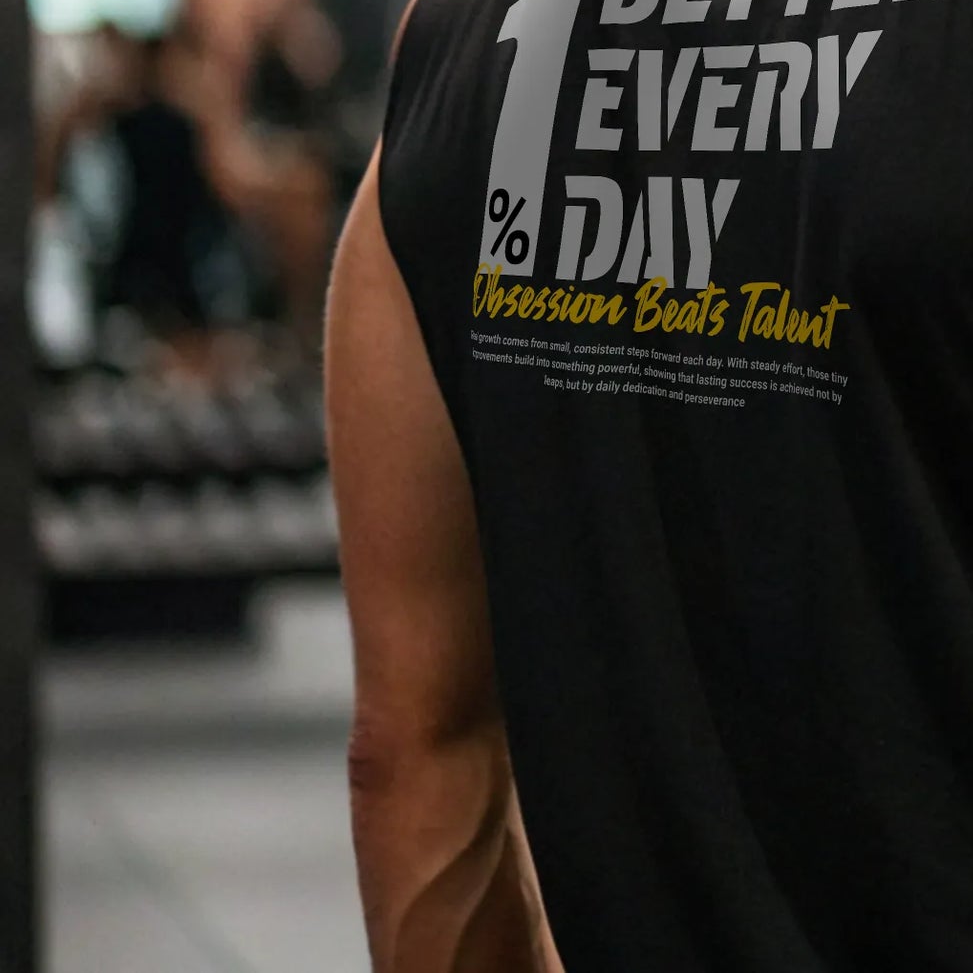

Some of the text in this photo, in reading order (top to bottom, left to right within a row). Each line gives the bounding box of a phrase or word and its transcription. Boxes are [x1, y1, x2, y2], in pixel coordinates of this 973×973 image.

[575, 30, 883, 151] EVERY
[556, 175, 740, 290] DAY
[472, 262, 851, 350] Obsession Beats Talent
[479, 333, 502, 345] growth
[502, 336, 529, 348] comes
[530, 338, 549, 350] from
[549, 341, 572, 355] small,
[574, 344, 625, 356] consistent
[627, 346, 650, 360] steps
[651, 348, 681, 364] forward
[682, 354, 704, 367] each
[706, 355, 724, 370] day.
[727, 356, 748, 369] With
[750, 360, 781, 375] steady
[782, 362, 806, 378] effort,
[807, 366, 830, 381] those
[831, 372, 849, 388] tiny
[514, 353, 535, 366] build
[536, 356, 551, 368] into
[551, 359, 596, 375] something
[597, 362, 642, 377] powerful,
[644, 365, 677, 384] showing
[678, 371, 694, 385] that
[696, 373, 728, 389] lasting
[729, 377, 768, 391] success
[769, 379, 778, 391] is
[779, 381, 815, 397] achieved
[816, 388, 831, 401] not
[832, 389, 843, 406] by
[543, 374, 746, 408] leaps, but by daily dedication and perseverance
